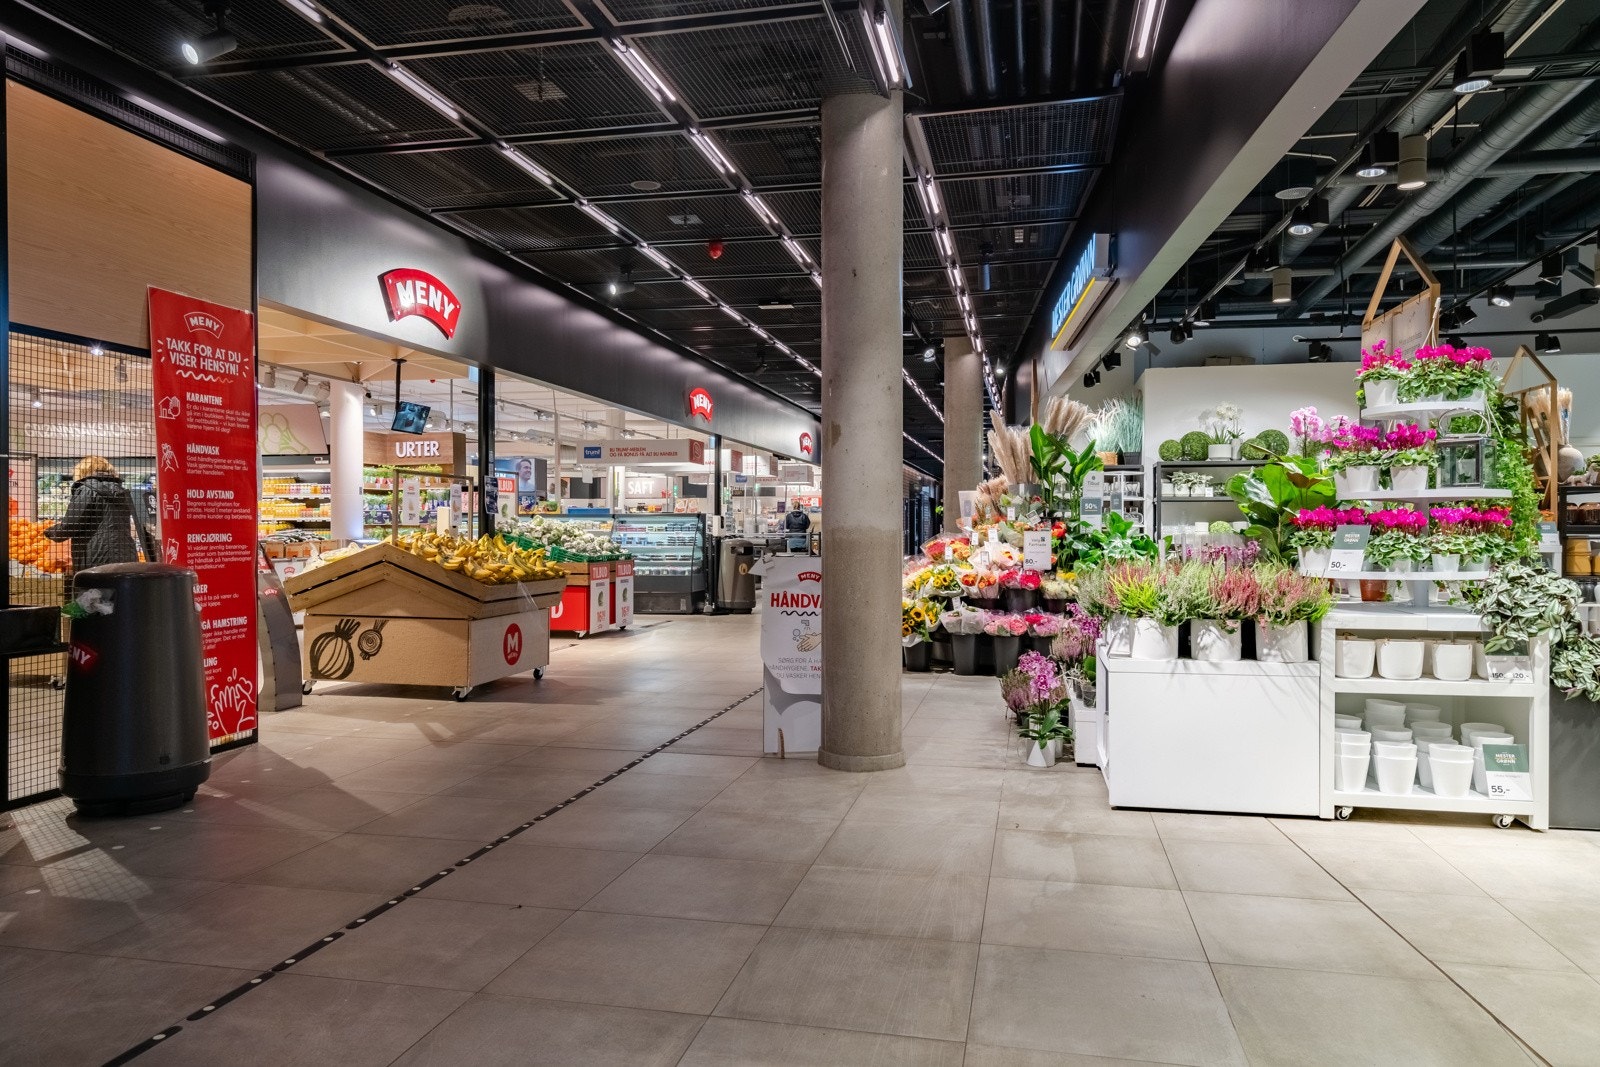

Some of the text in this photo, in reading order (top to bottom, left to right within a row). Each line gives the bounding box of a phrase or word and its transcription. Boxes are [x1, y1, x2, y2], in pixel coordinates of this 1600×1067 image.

[396, 280, 455, 320] MENY
[189, 316, 220, 331] MENY
[166, 337, 241, 363] TAKK FOR AT DU
[170, 351, 239, 376] VISER HENSYN!
[186, 392, 222, 406] KARANTENE
[693, 394, 712, 413] MENY
[186, 442, 220, 456] HÅNDVASK
[396, 440, 440, 458] URTER
[198, 456, 226, 464] håndhygiene
[498, 479, 514, 492] ILBUD
[628, 481, 654, 495] SAFT
[186, 489, 234, 500] HOLD AVSTAND
[187, 533, 232, 542] RENGJØRING
[193, 584, 208, 594] ARER
[770, 590, 822, 609] HÅNDV
[201, 616, 248, 630] GÅ HAMSTRING
[204, 657, 218, 668] LING
[1491, 786, 1510, 794] 55,-
